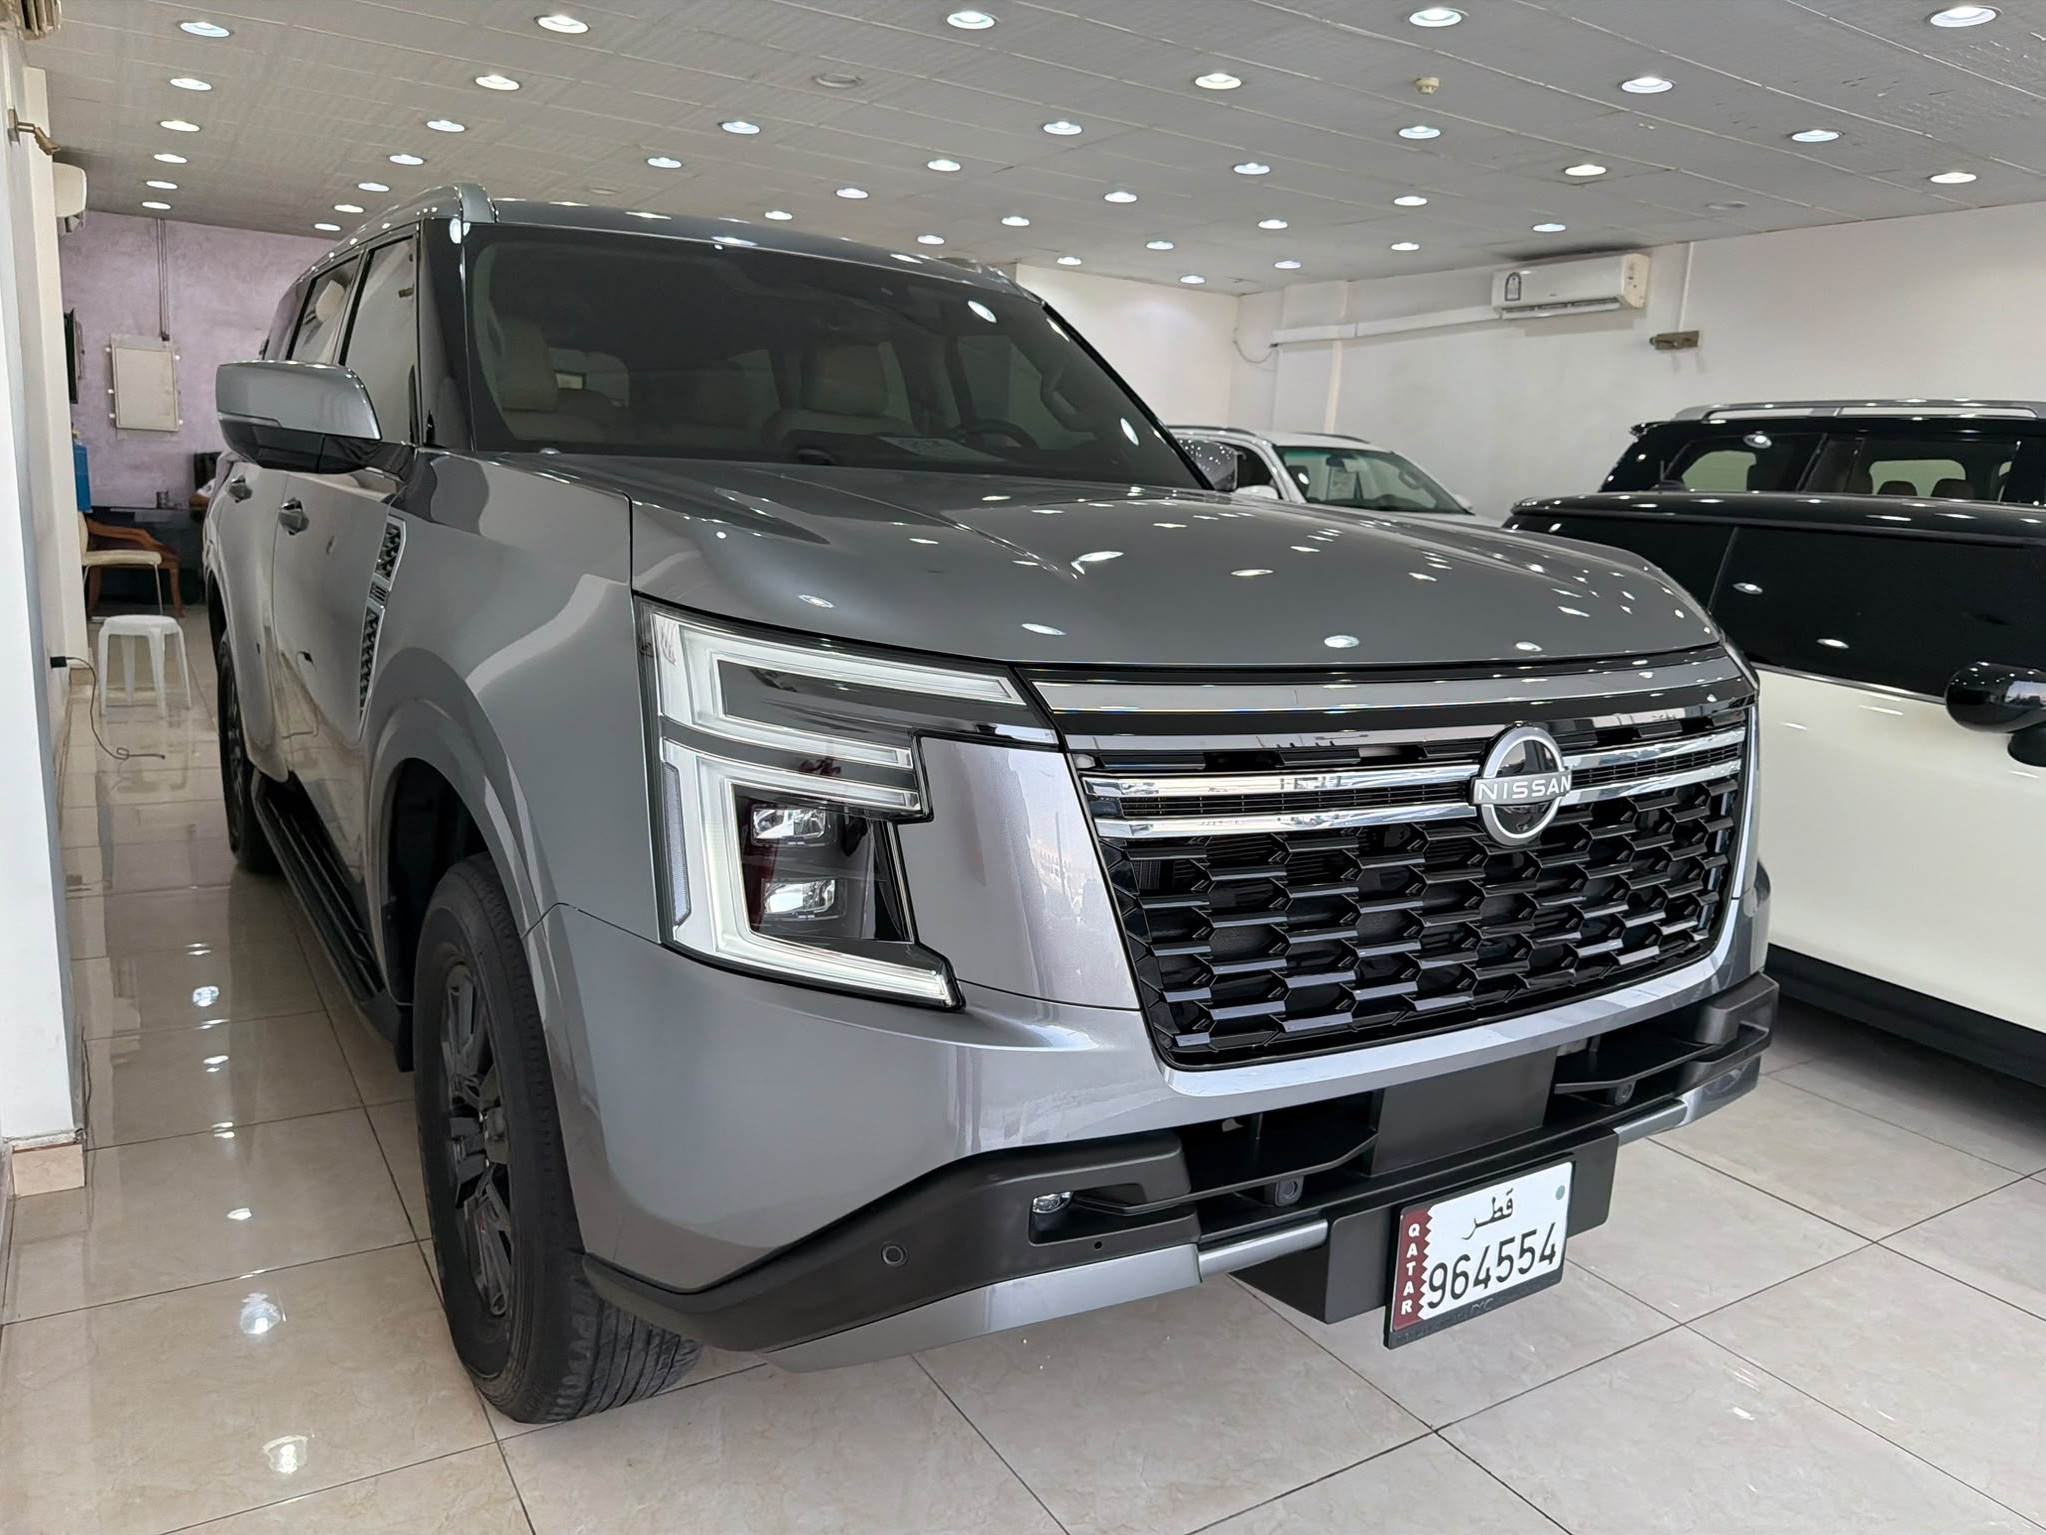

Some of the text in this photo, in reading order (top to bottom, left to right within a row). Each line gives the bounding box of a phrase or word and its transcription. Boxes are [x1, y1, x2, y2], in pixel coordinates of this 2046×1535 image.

[1478, 774, 1571, 801] NISSAN
[1462, 1187, 1513, 1240] قطر
[1401, 1223, 1421, 1316] QATAR
[1427, 1222, 1556, 1310] 964554
